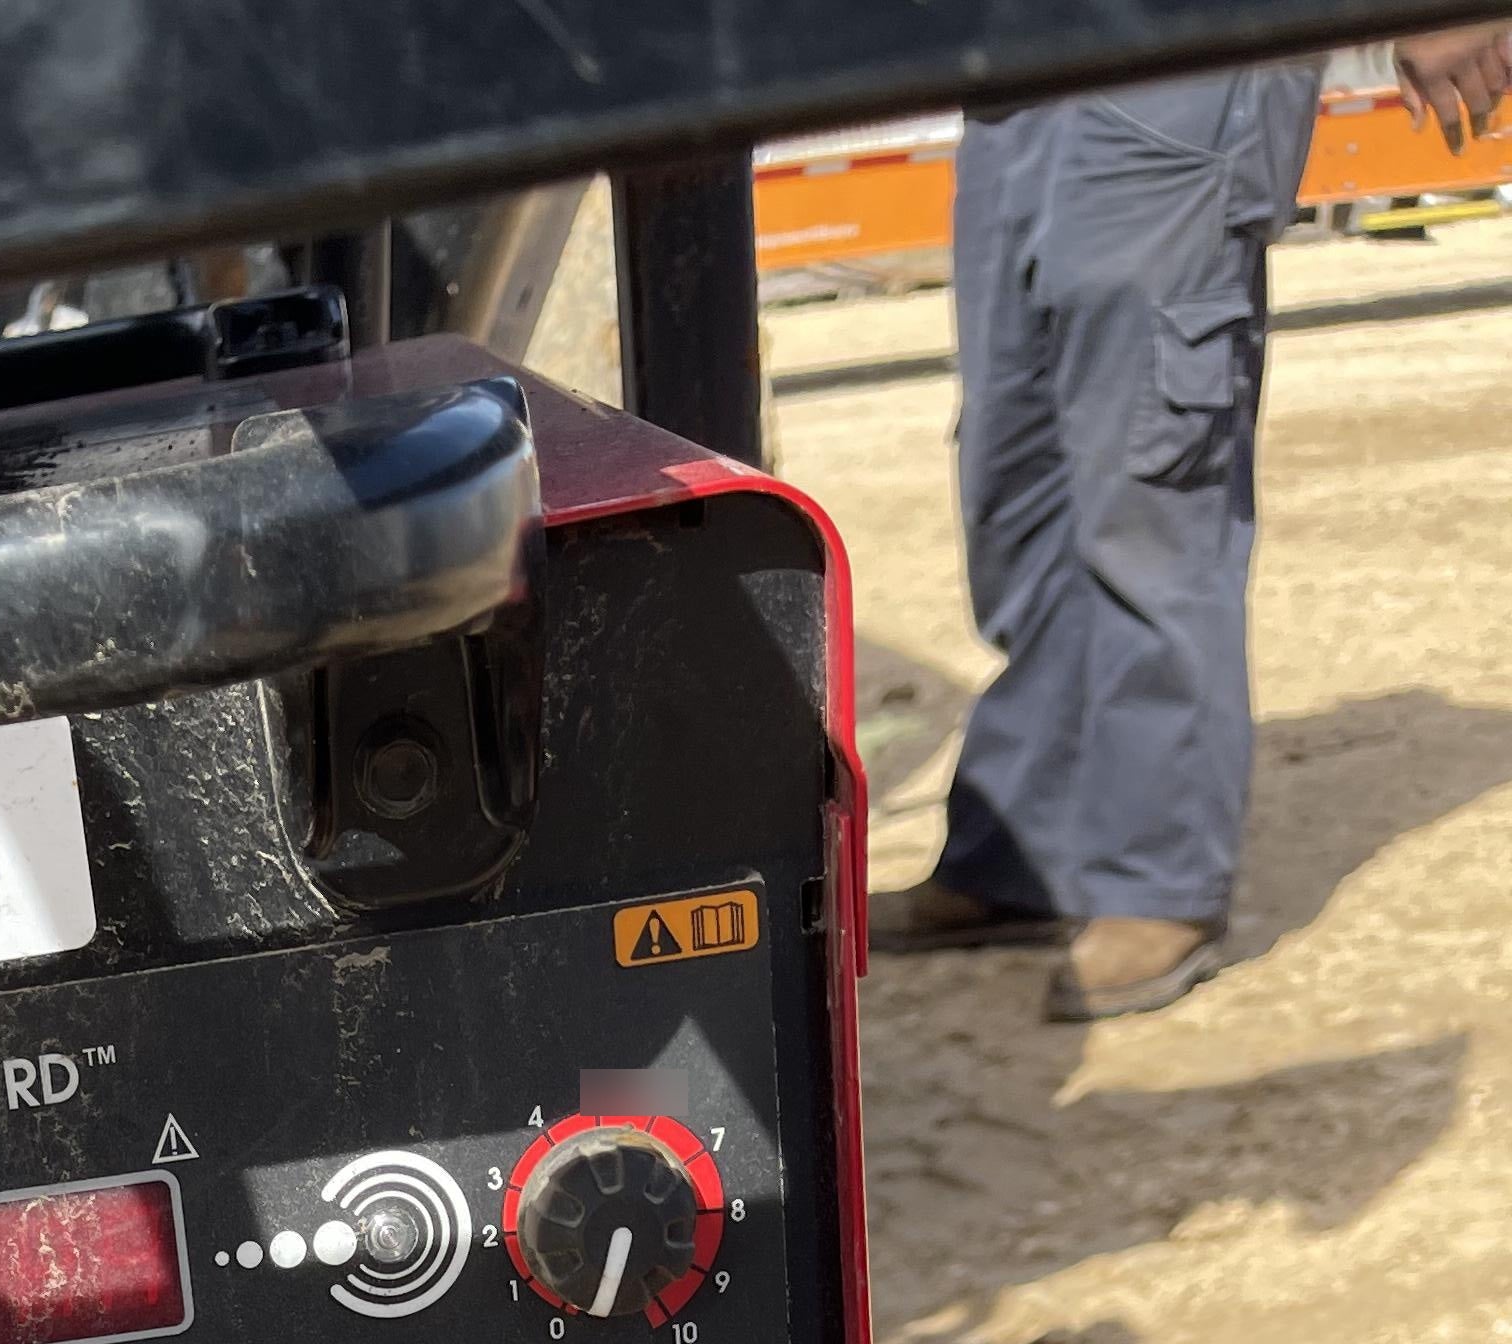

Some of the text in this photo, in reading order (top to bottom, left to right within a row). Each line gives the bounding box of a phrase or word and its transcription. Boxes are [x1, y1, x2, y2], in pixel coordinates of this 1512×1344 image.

[528, 1105, 544, 1128] 4
[710, 1127, 726, 1152] 7
[487, 1166, 504, 1191] 3
[730, 1198, 746, 1222] 8
[482, 1224, 499, 1249] 2
[508, 1279, 519, 1301] 1
[715, 1270, 731, 1293] 9
[549, 1317, 565, 1339] 0
[672, 1322, 698, 1344] 10
